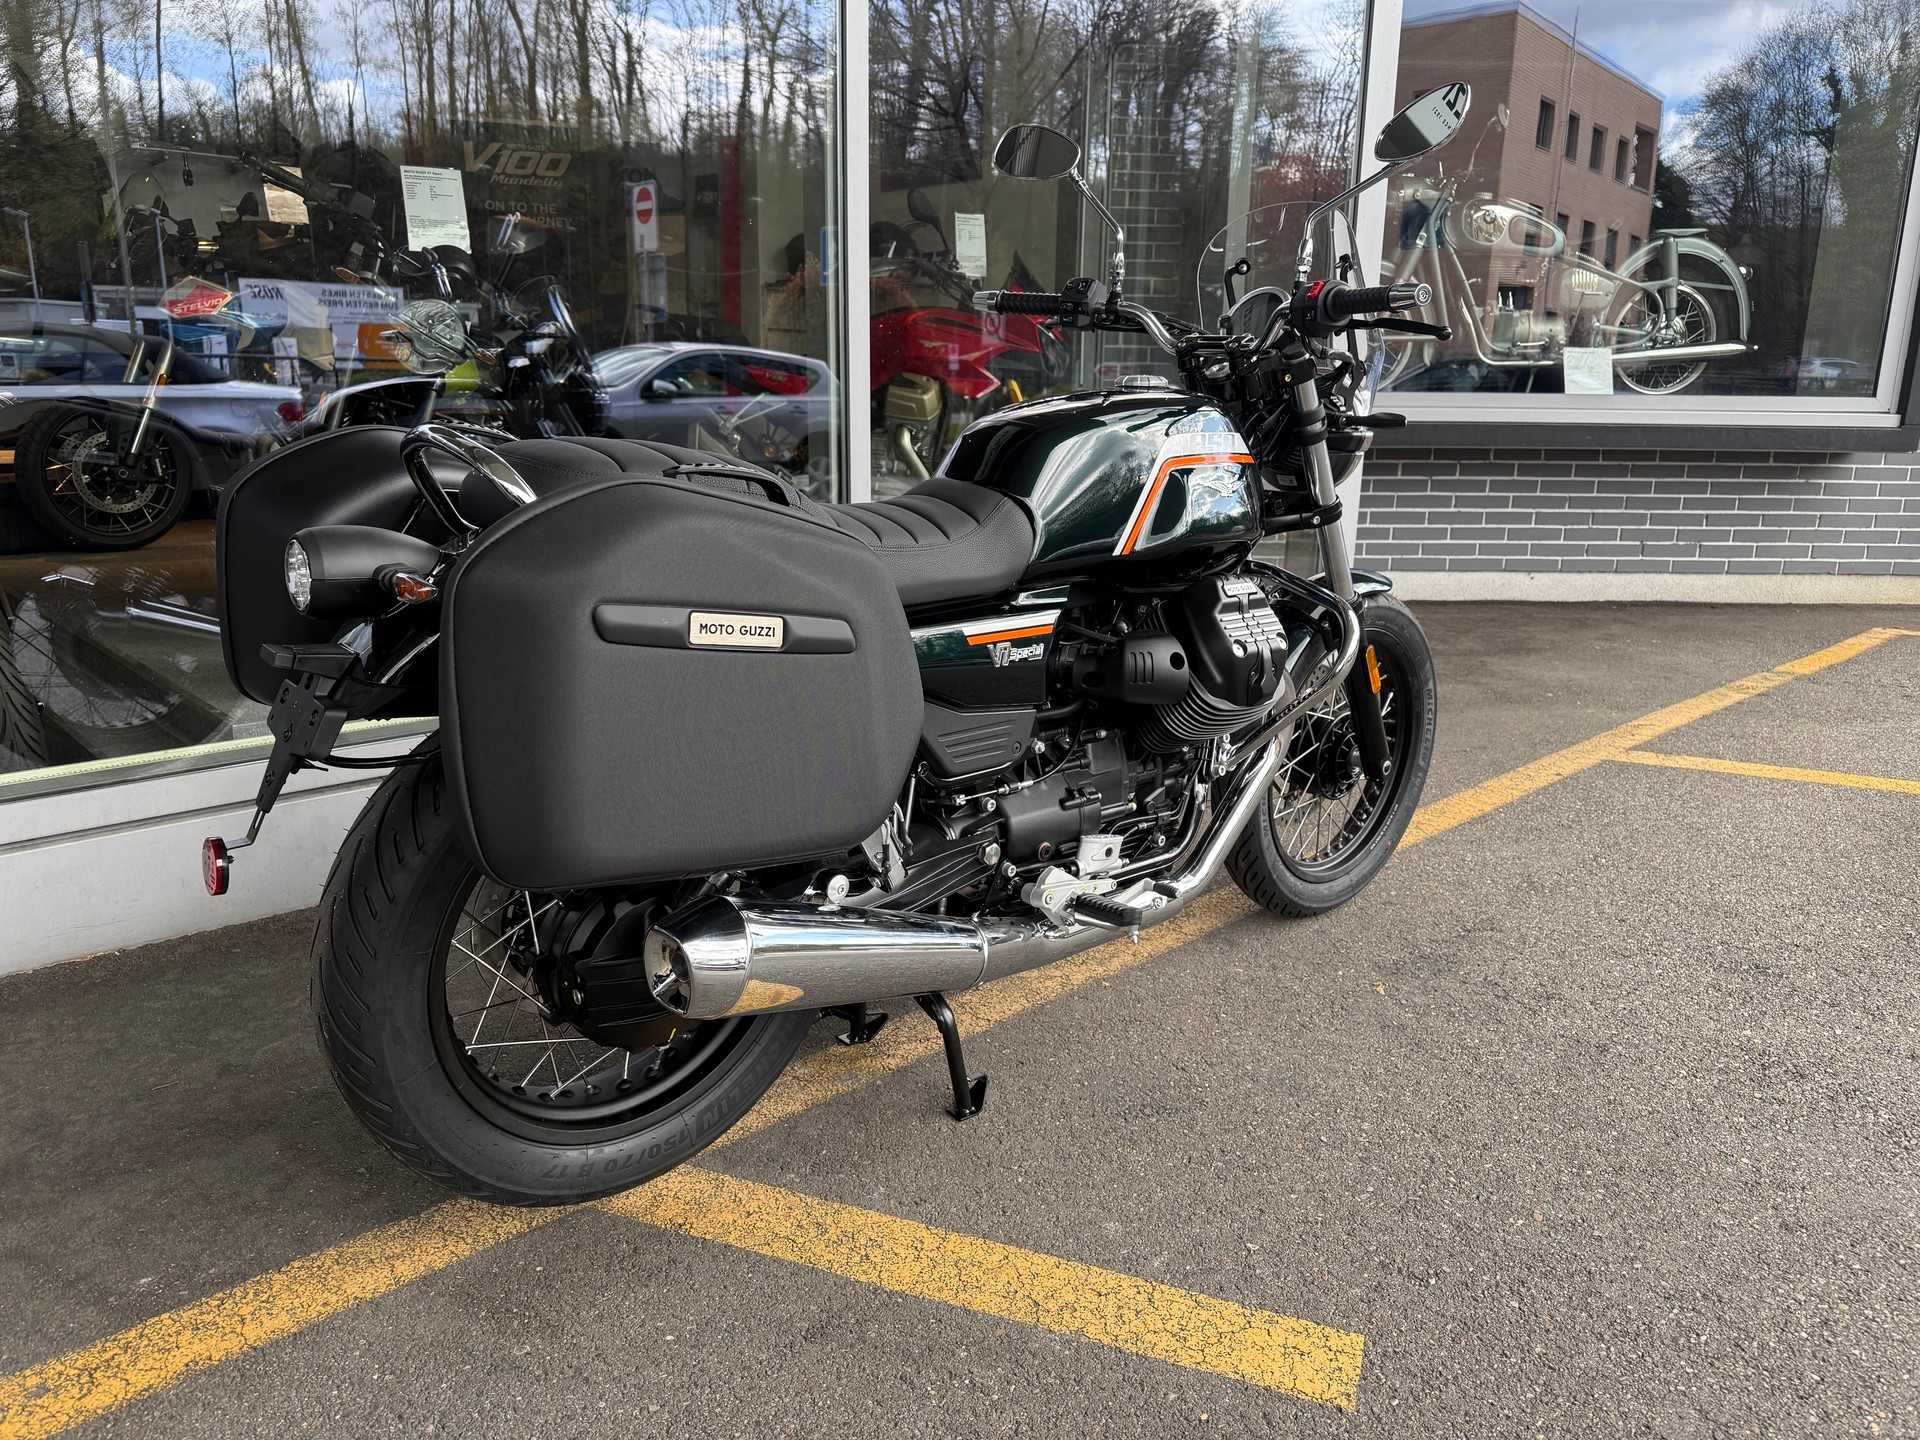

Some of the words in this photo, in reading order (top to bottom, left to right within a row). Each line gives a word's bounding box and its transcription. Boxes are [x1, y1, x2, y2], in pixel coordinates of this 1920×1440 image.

[463, 140, 572, 177] V100
[489, 174, 564, 187] Mandello
[484, 200, 505, 211] ON
[508, 201, 528, 212] TO
[531, 203, 557, 213] THE
[173, 297, 223, 314] STELVIO
[699, 622, 735, 635] MOTO
[739, 625, 775, 638] GUZZI
[987, 641, 1011, 668] V7
[1009, 642, 1045, 661] Special
[1421, 688, 1433, 763] MICHELIN
[603, 1128, 688, 1174] 150/70
[541, 1164, 570, 1179] 17
[576, 1162, 595, 1179] B
